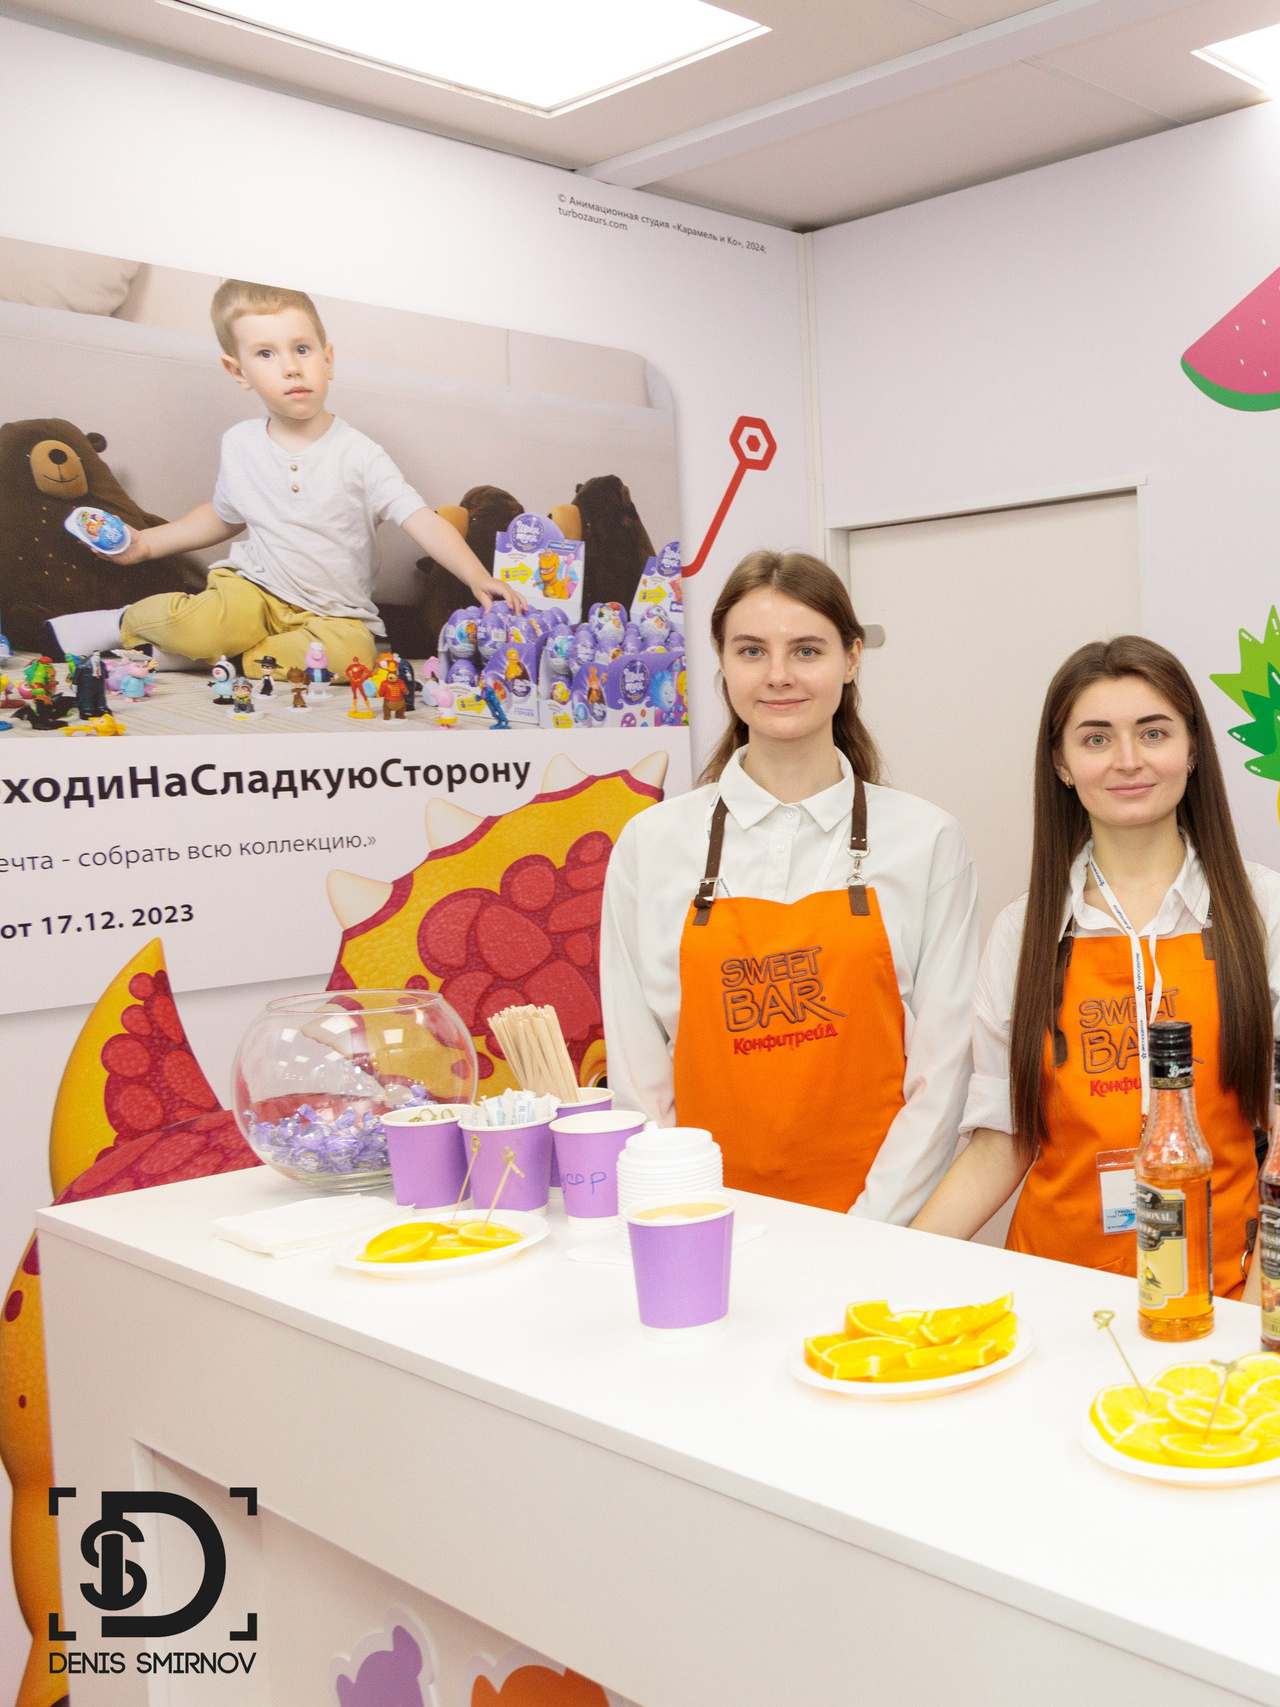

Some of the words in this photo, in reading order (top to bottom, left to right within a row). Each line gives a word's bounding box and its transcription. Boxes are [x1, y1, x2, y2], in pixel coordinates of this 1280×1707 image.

[558, 207, 628, 231] turbozaurs.com
[569, 196, 639, 222] Анимационная
[641, 214, 670, 230] студия
[672, 223, 718, 242] «Карамель
[0, 758, 531, 809] ходиНаСладкуюСторону
[78, 845, 180, 869] собрать
[188, 843, 232, 859] всю
[240, 834, 377, 856] коллекцию.»
[0, 922, 32, 939] от
[41, 911, 124, 935] 17.12.
[131, 904, 194, 927] 2023
[721, 945, 822, 987] SWEET
[723, 977, 848, 1032] BAR
[1090, 1076, 1142, 1098] Конфи
